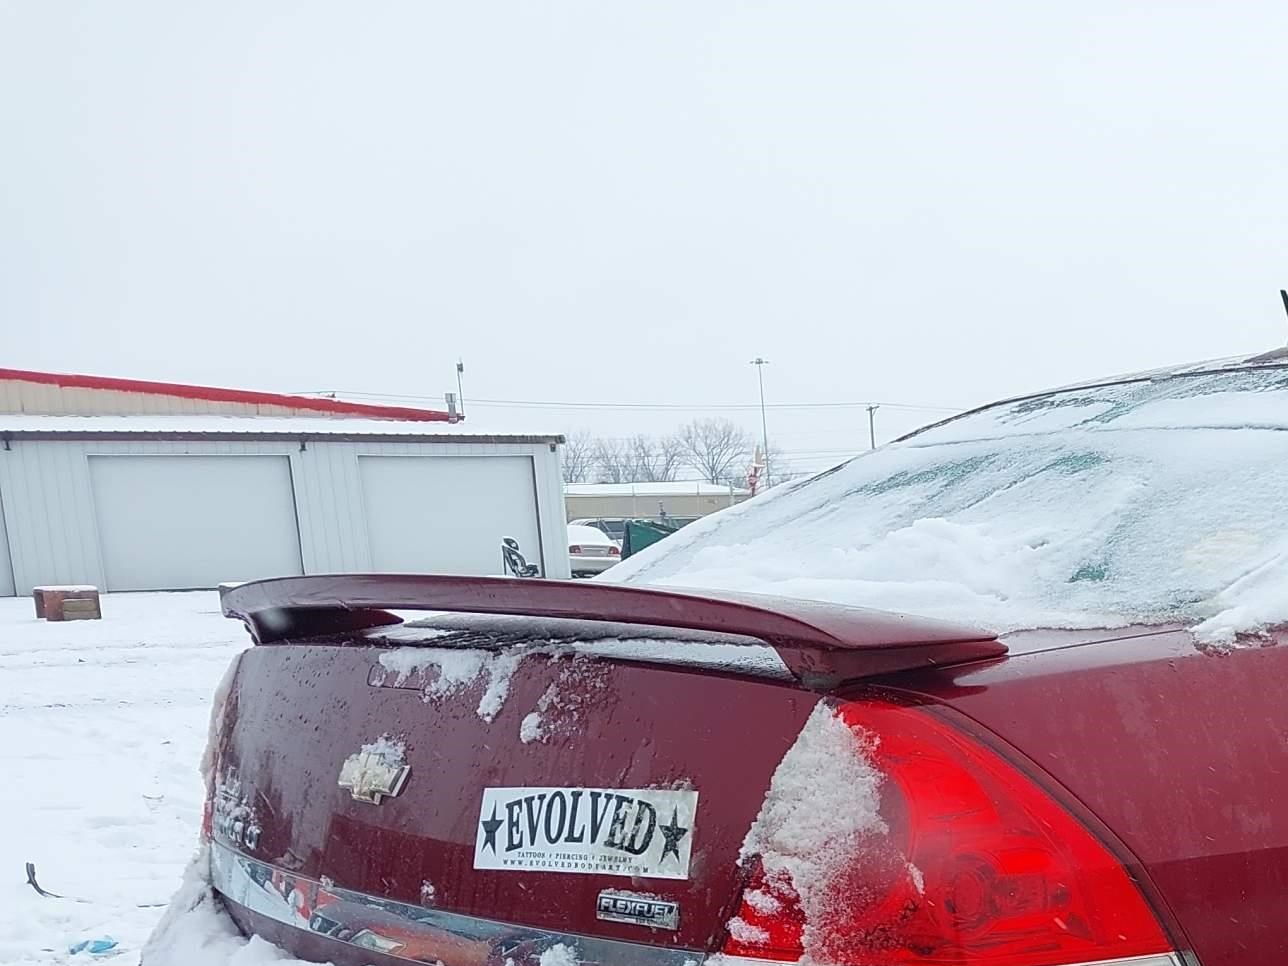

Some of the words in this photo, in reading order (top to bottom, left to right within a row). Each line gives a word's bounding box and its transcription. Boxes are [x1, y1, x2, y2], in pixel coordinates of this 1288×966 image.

[504, 790, 657, 856] EVOLVED
[517, 851, 546, 859] TATTOOS
[555, 853, 588, 861] PIERCING
[599, 855, 633, 863] JEWELRY
